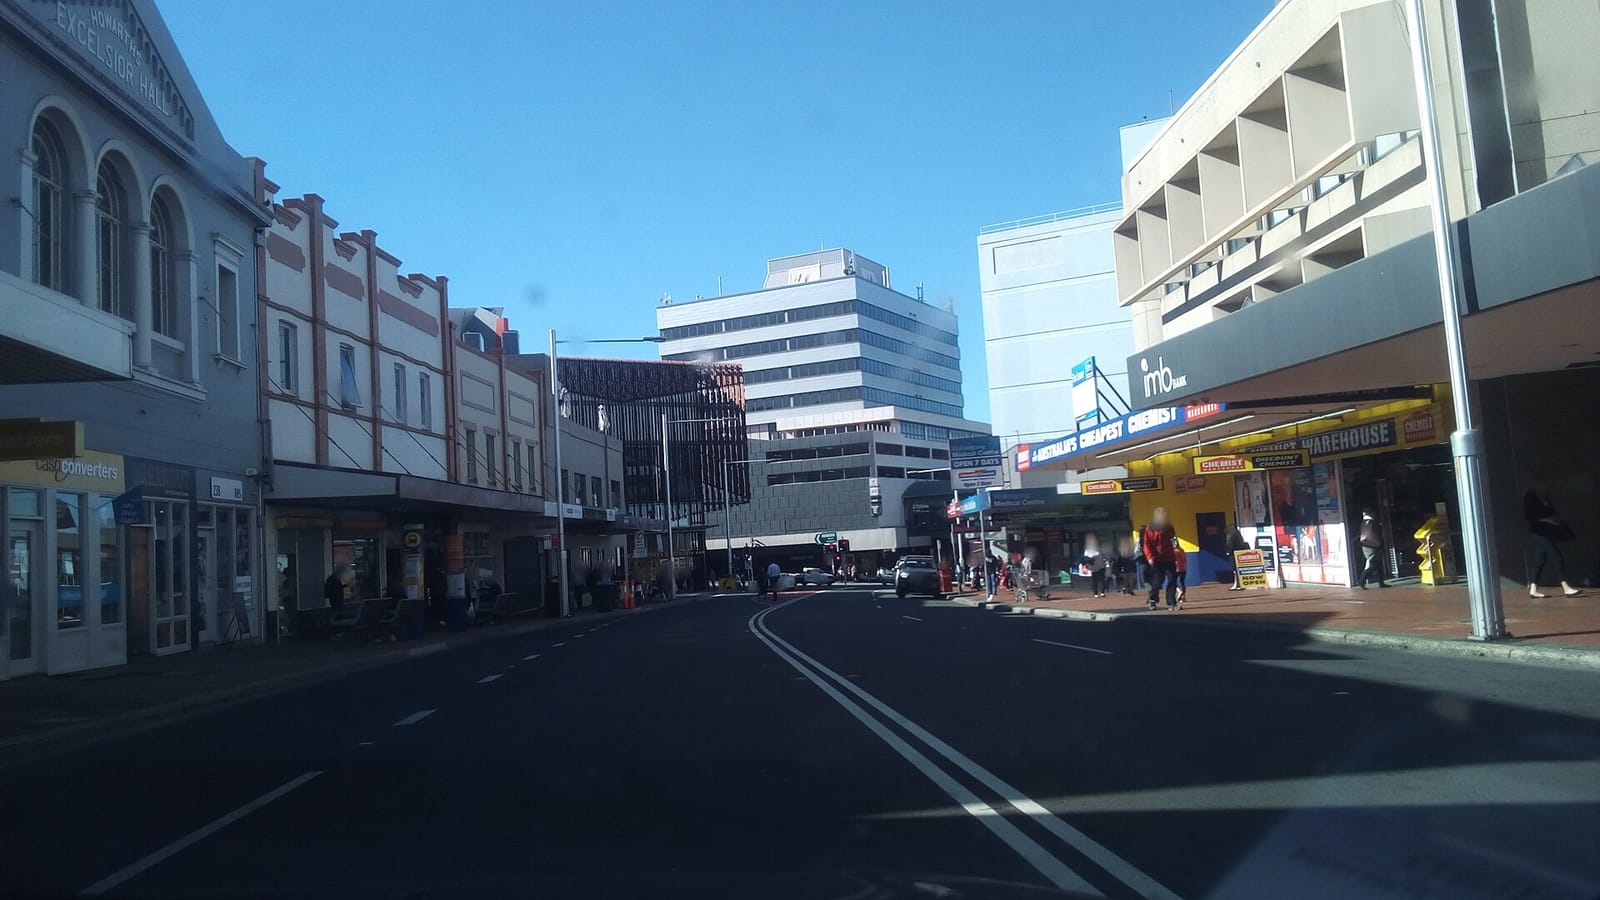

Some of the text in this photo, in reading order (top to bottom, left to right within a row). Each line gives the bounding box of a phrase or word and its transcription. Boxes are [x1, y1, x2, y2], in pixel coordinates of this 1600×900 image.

[57, 1, 169, 117] EXCELSIOR HALL
[1140, 356, 1172, 398] imb
[1172, 375, 1188, 389] BANK
[1080, 420, 1123, 449] CHEAPEST
[1128, 406, 1177, 434] CHEMIST
[1405, 417, 1433, 433] CHEMIST
[1302, 423, 1389, 455] WAREHOUSE
[62, 459, 118, 480] converters
[1201, 459, 1243, 469] CHEMIST
